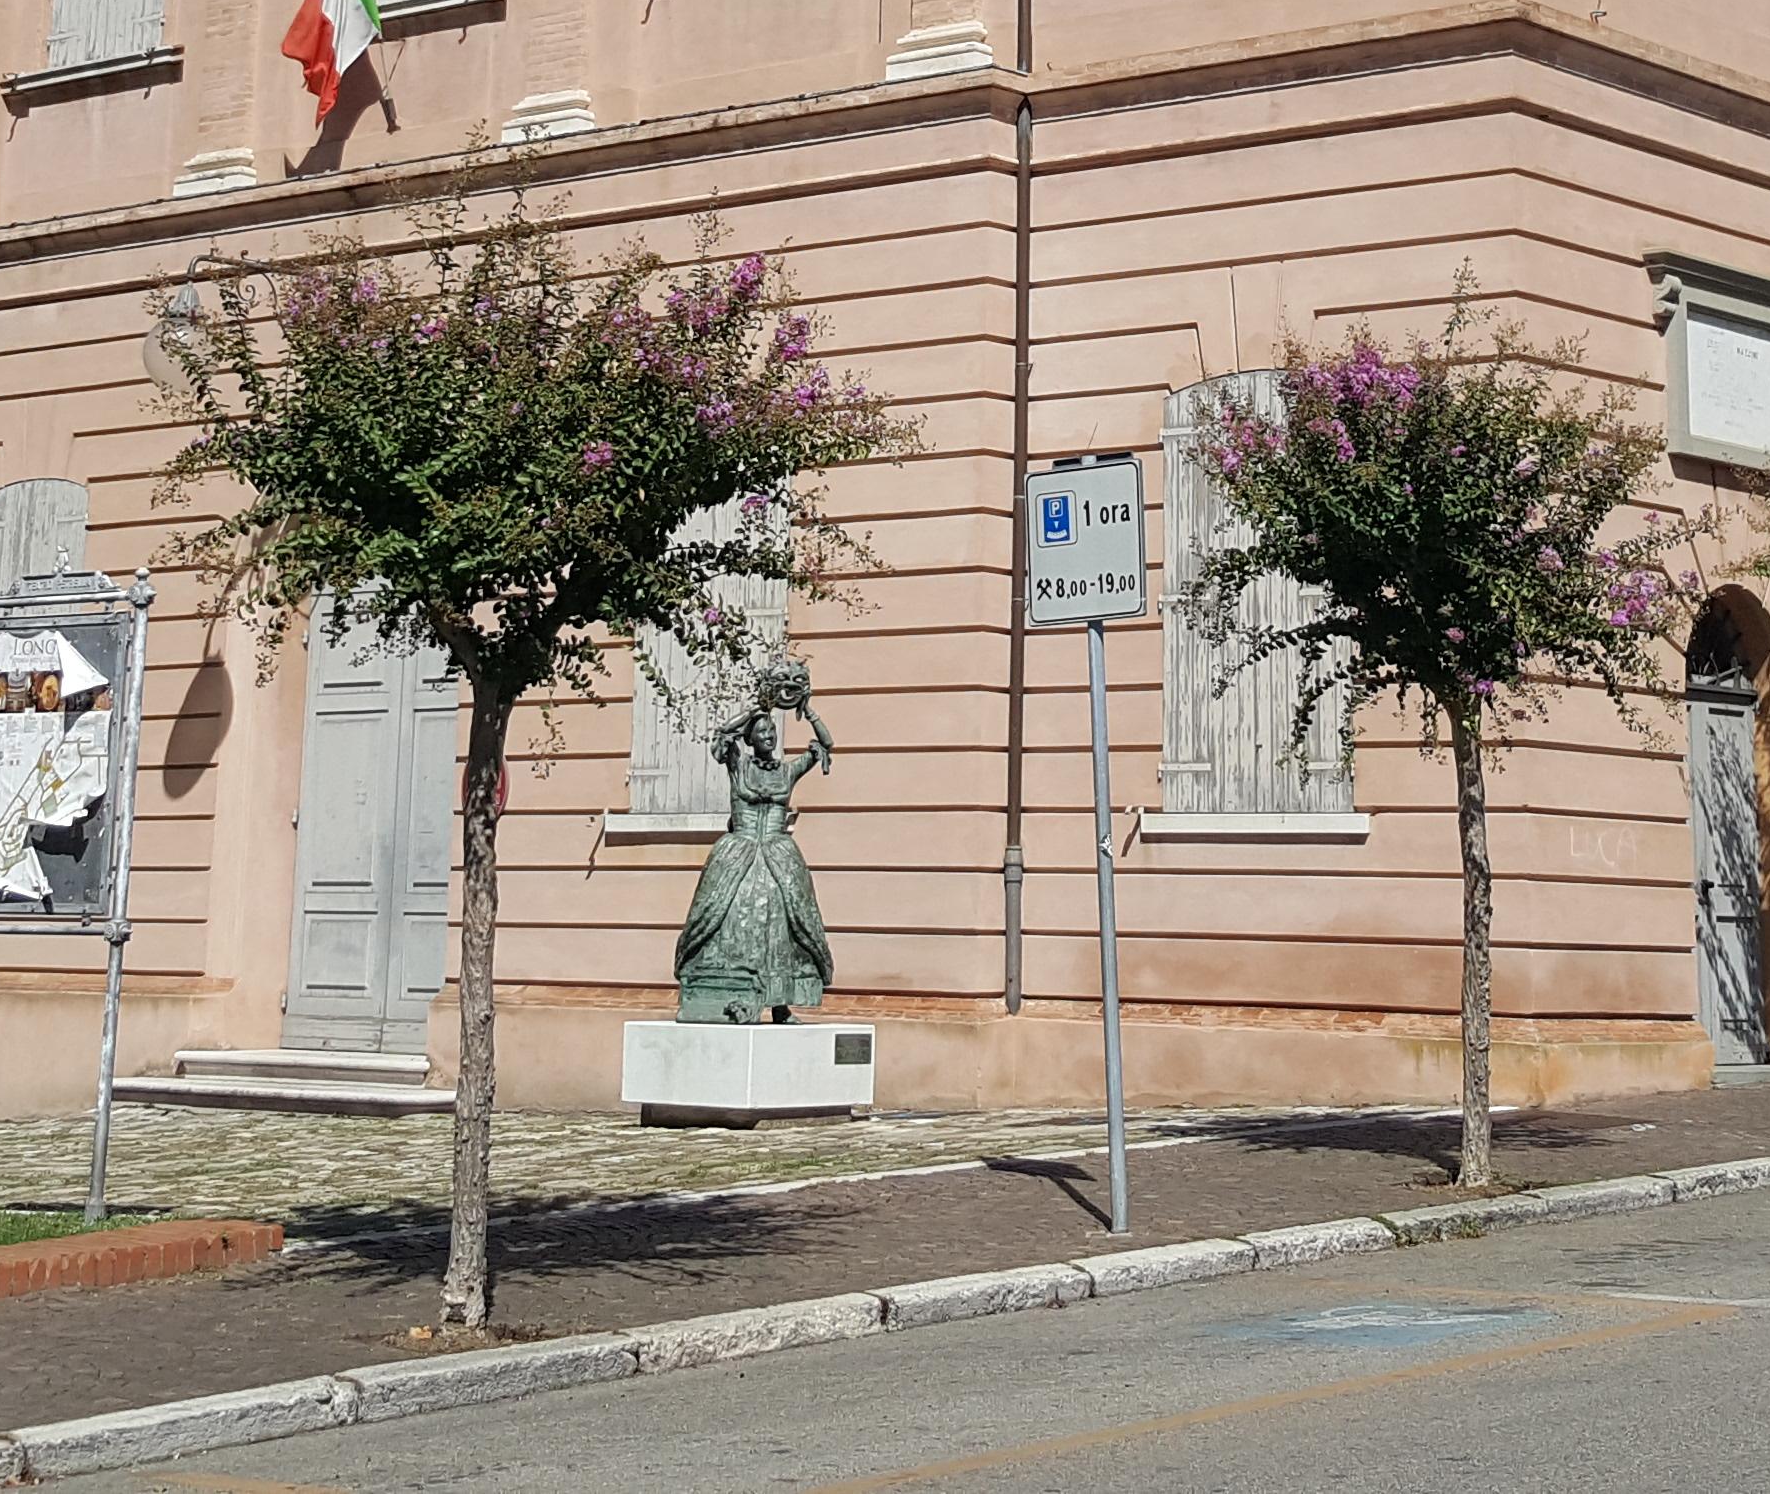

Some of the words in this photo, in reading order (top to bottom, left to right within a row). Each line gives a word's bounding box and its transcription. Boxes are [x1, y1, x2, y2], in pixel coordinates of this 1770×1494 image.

[1083, 500, 1091, 526] 1
[1100, 503, 1130, 525] ora
[1569, 825, 1637, 868] LUCA
